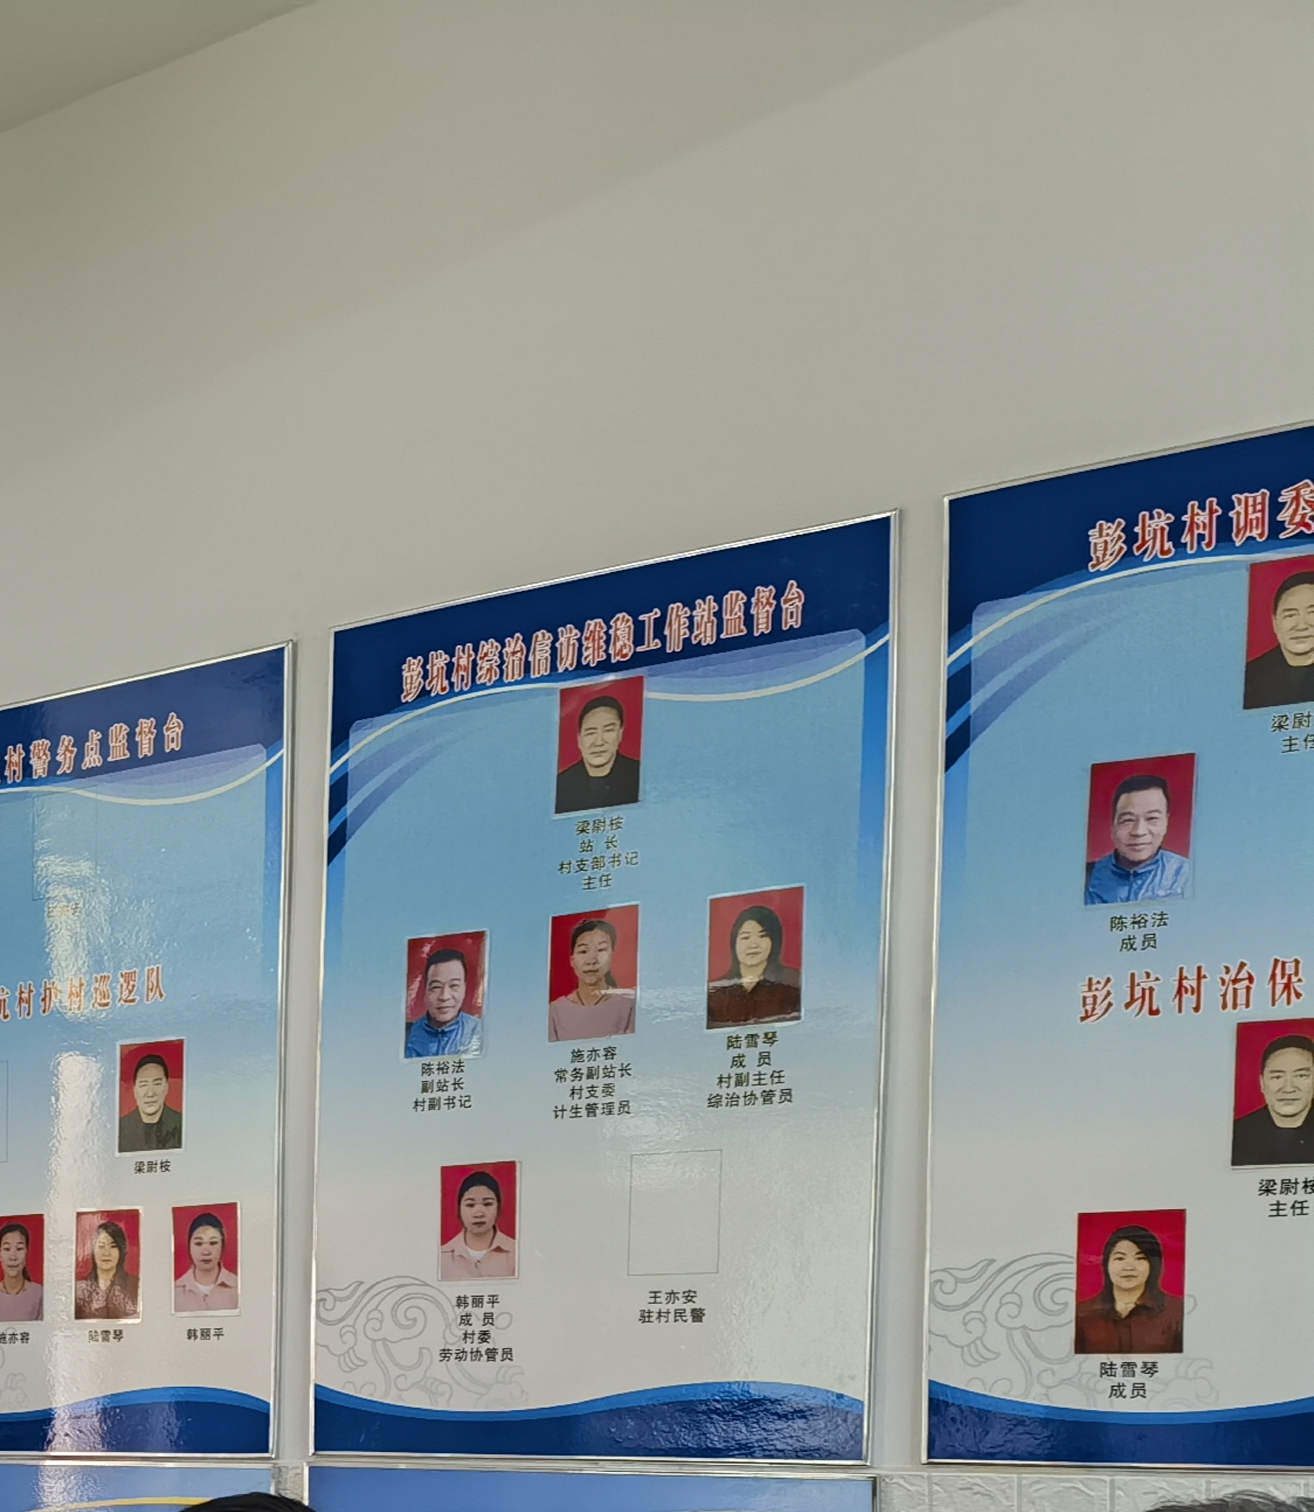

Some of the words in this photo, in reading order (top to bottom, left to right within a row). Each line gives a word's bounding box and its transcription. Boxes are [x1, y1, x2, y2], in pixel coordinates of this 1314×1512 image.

[400, 579, 806, 704] 彭坑村综治信访维稳工作站监督台
[557, 851, 641, 876] 村支部书记
[581, 872, 613, 892] 主任
[1109, 910, 1170, 933] 陈裕法
[1118, 931, 1159, 953] 成员
[1079, 956, 1306, 1026] 彭坑村治保
[725, 1031, 780, 1051] 陆雪琴
[569, 1046, 618, 1064] 施亦容
[729, 1050, 773, 1070] 成员
[419, 1060, 466, 1077] 陈裕法
[553, 1063, 633, 1083] 常务副站长
[715, 1068, 786, 1089] 村副主任
[419, 1077, 466, 1095] 副站长
[569, 1081, 616, 1101] 村支委
[412, 1094, 473, 1113] 村副书记
[706, 1087, 794, 1110] 综治协管员
[552, 1099, 632, 1121] 计生管理员
[1268, 1199, 1310, 1218] 主任
[455, 1293, 500, 1310] 韩丽平
[647, 1288, 698, 1307] 王亦安
[458, 1311, 496, 1329] 成员
[637, 1305, 706, 1325] 驻村民警
[185, 1326, 225, 1342] 韩丽平
[462, 1328, 492, 1346] 村委
[439, 1345, 514, 1364] 劳动协管员
[1099, 1360, 1159, 1379] 陆雪琴
[1108, 1380, 1148, 1400] 成员
